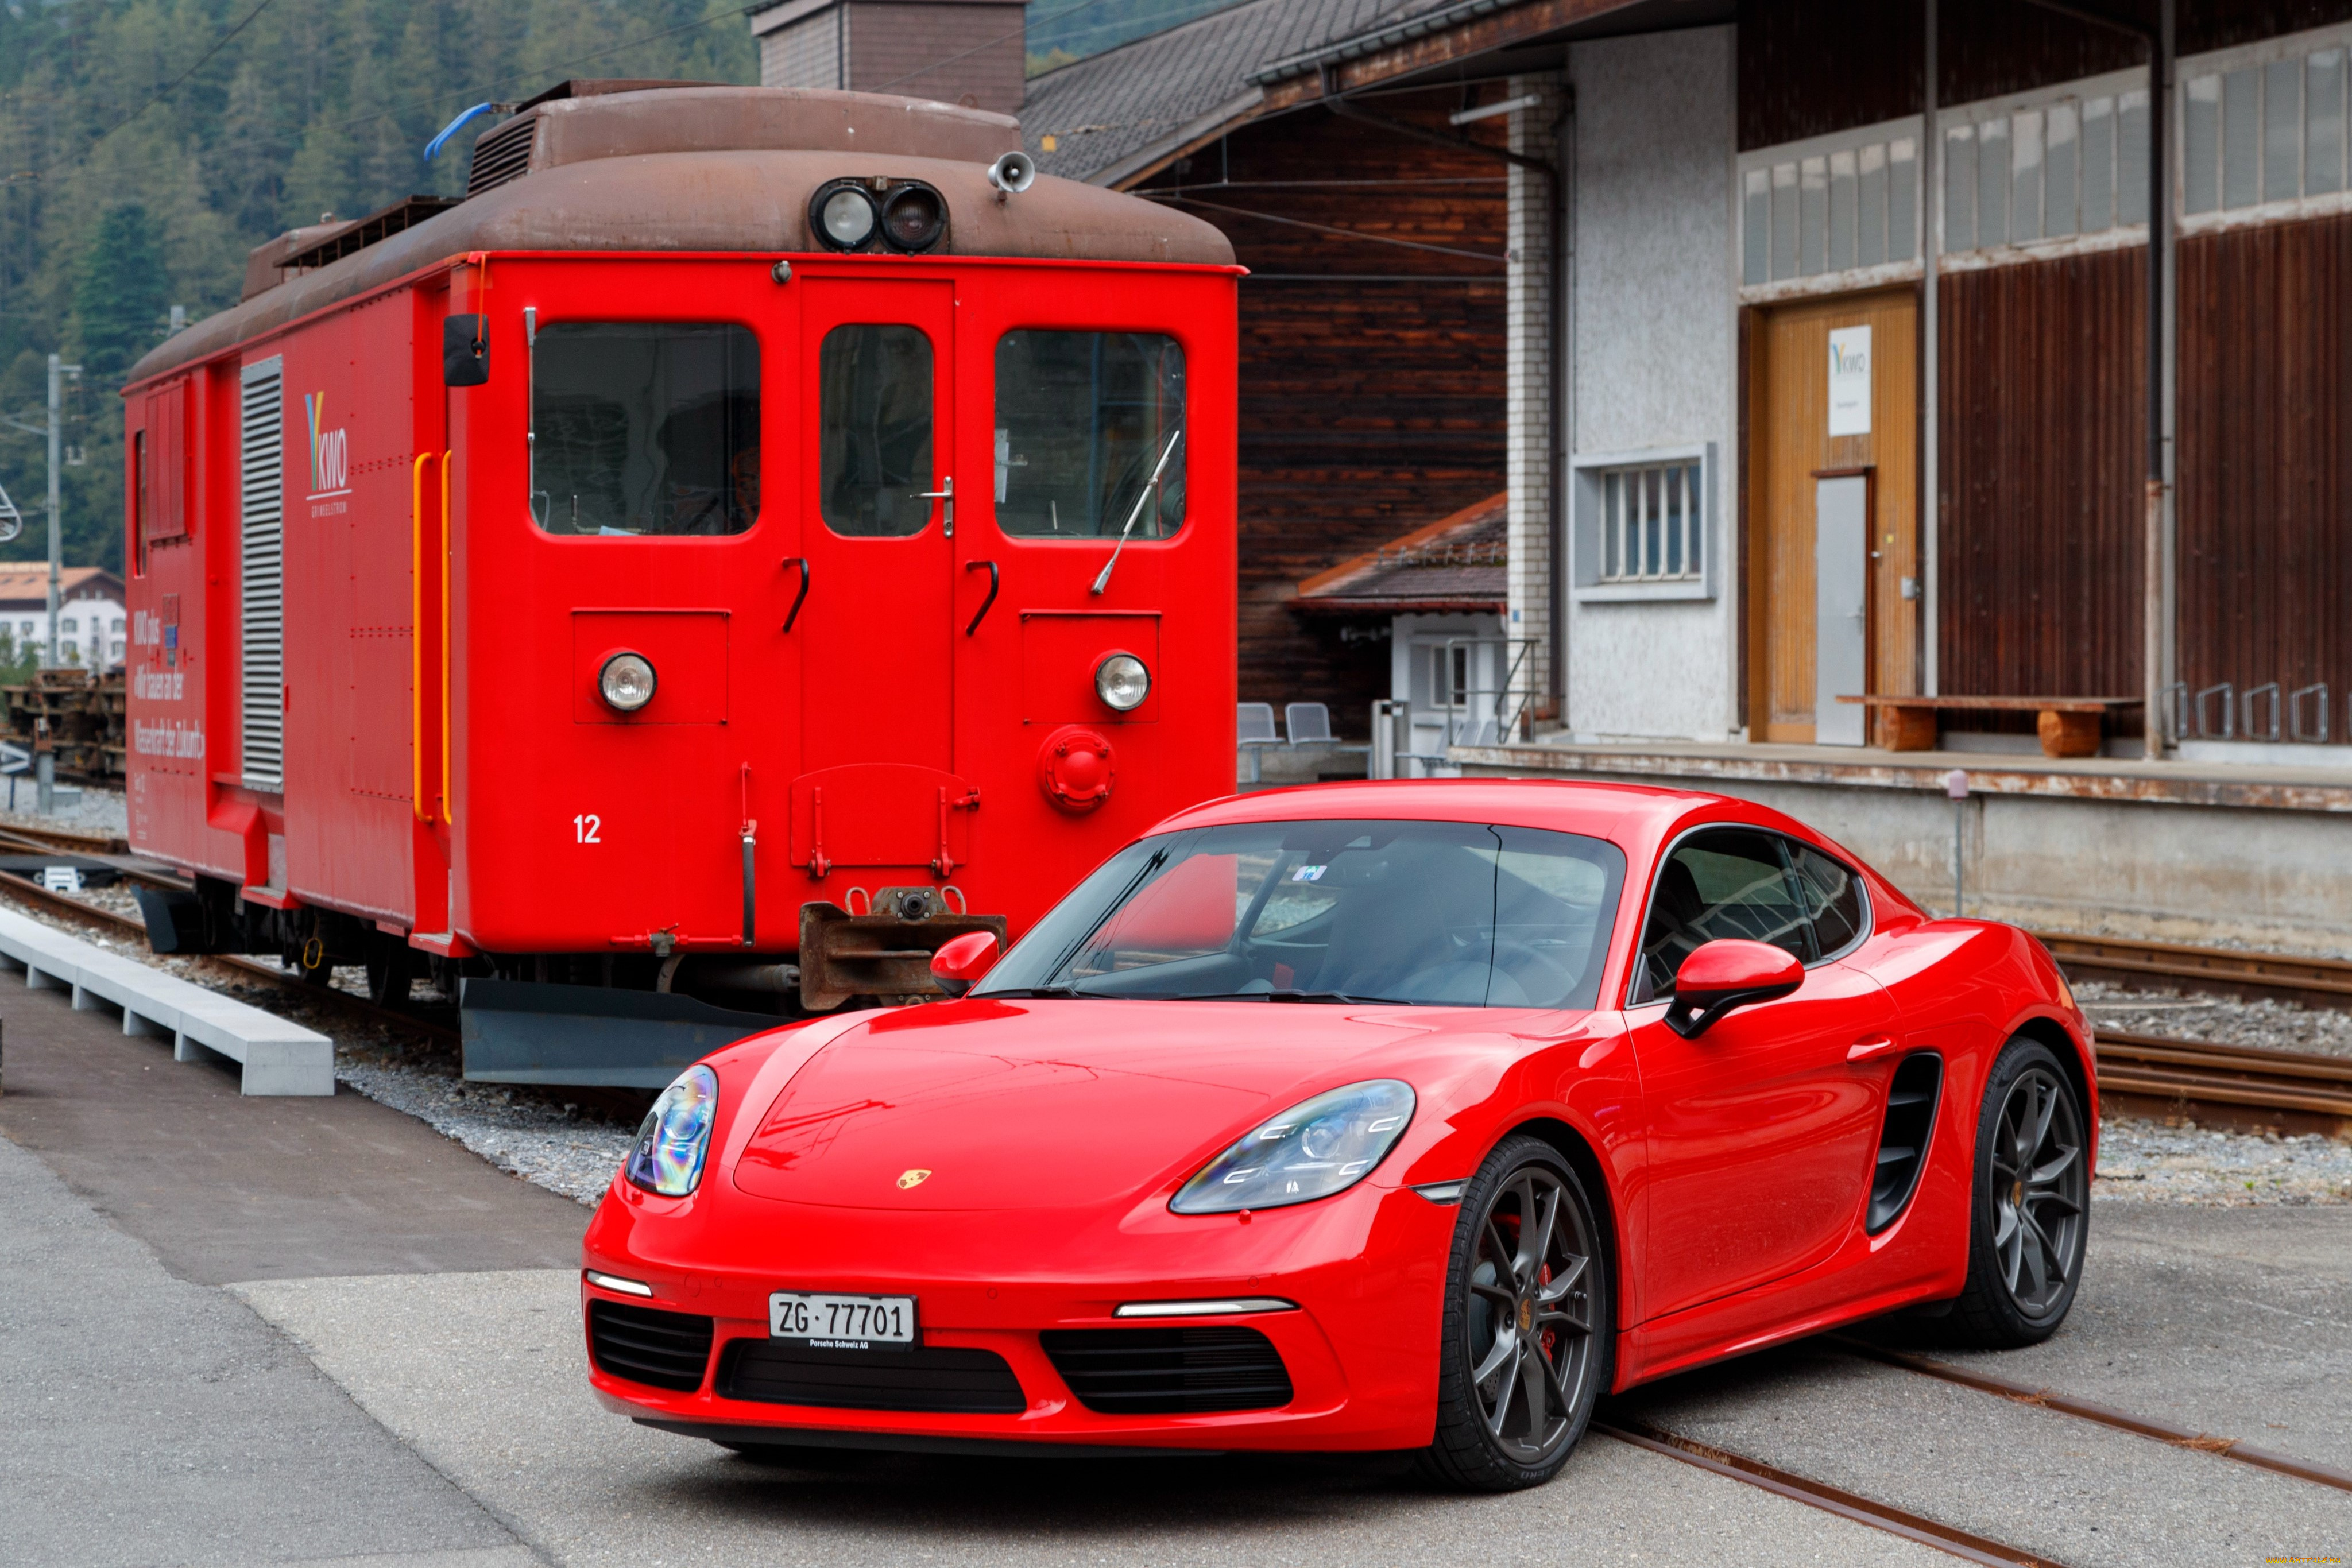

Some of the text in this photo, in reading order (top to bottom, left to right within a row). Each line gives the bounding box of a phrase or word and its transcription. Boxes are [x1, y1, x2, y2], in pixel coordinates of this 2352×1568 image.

[318, 428, 347, 491] KWO
[573, 814, 601, 843] 12
[810, 1339, 869, 1349] Porsche Schweiz AG
